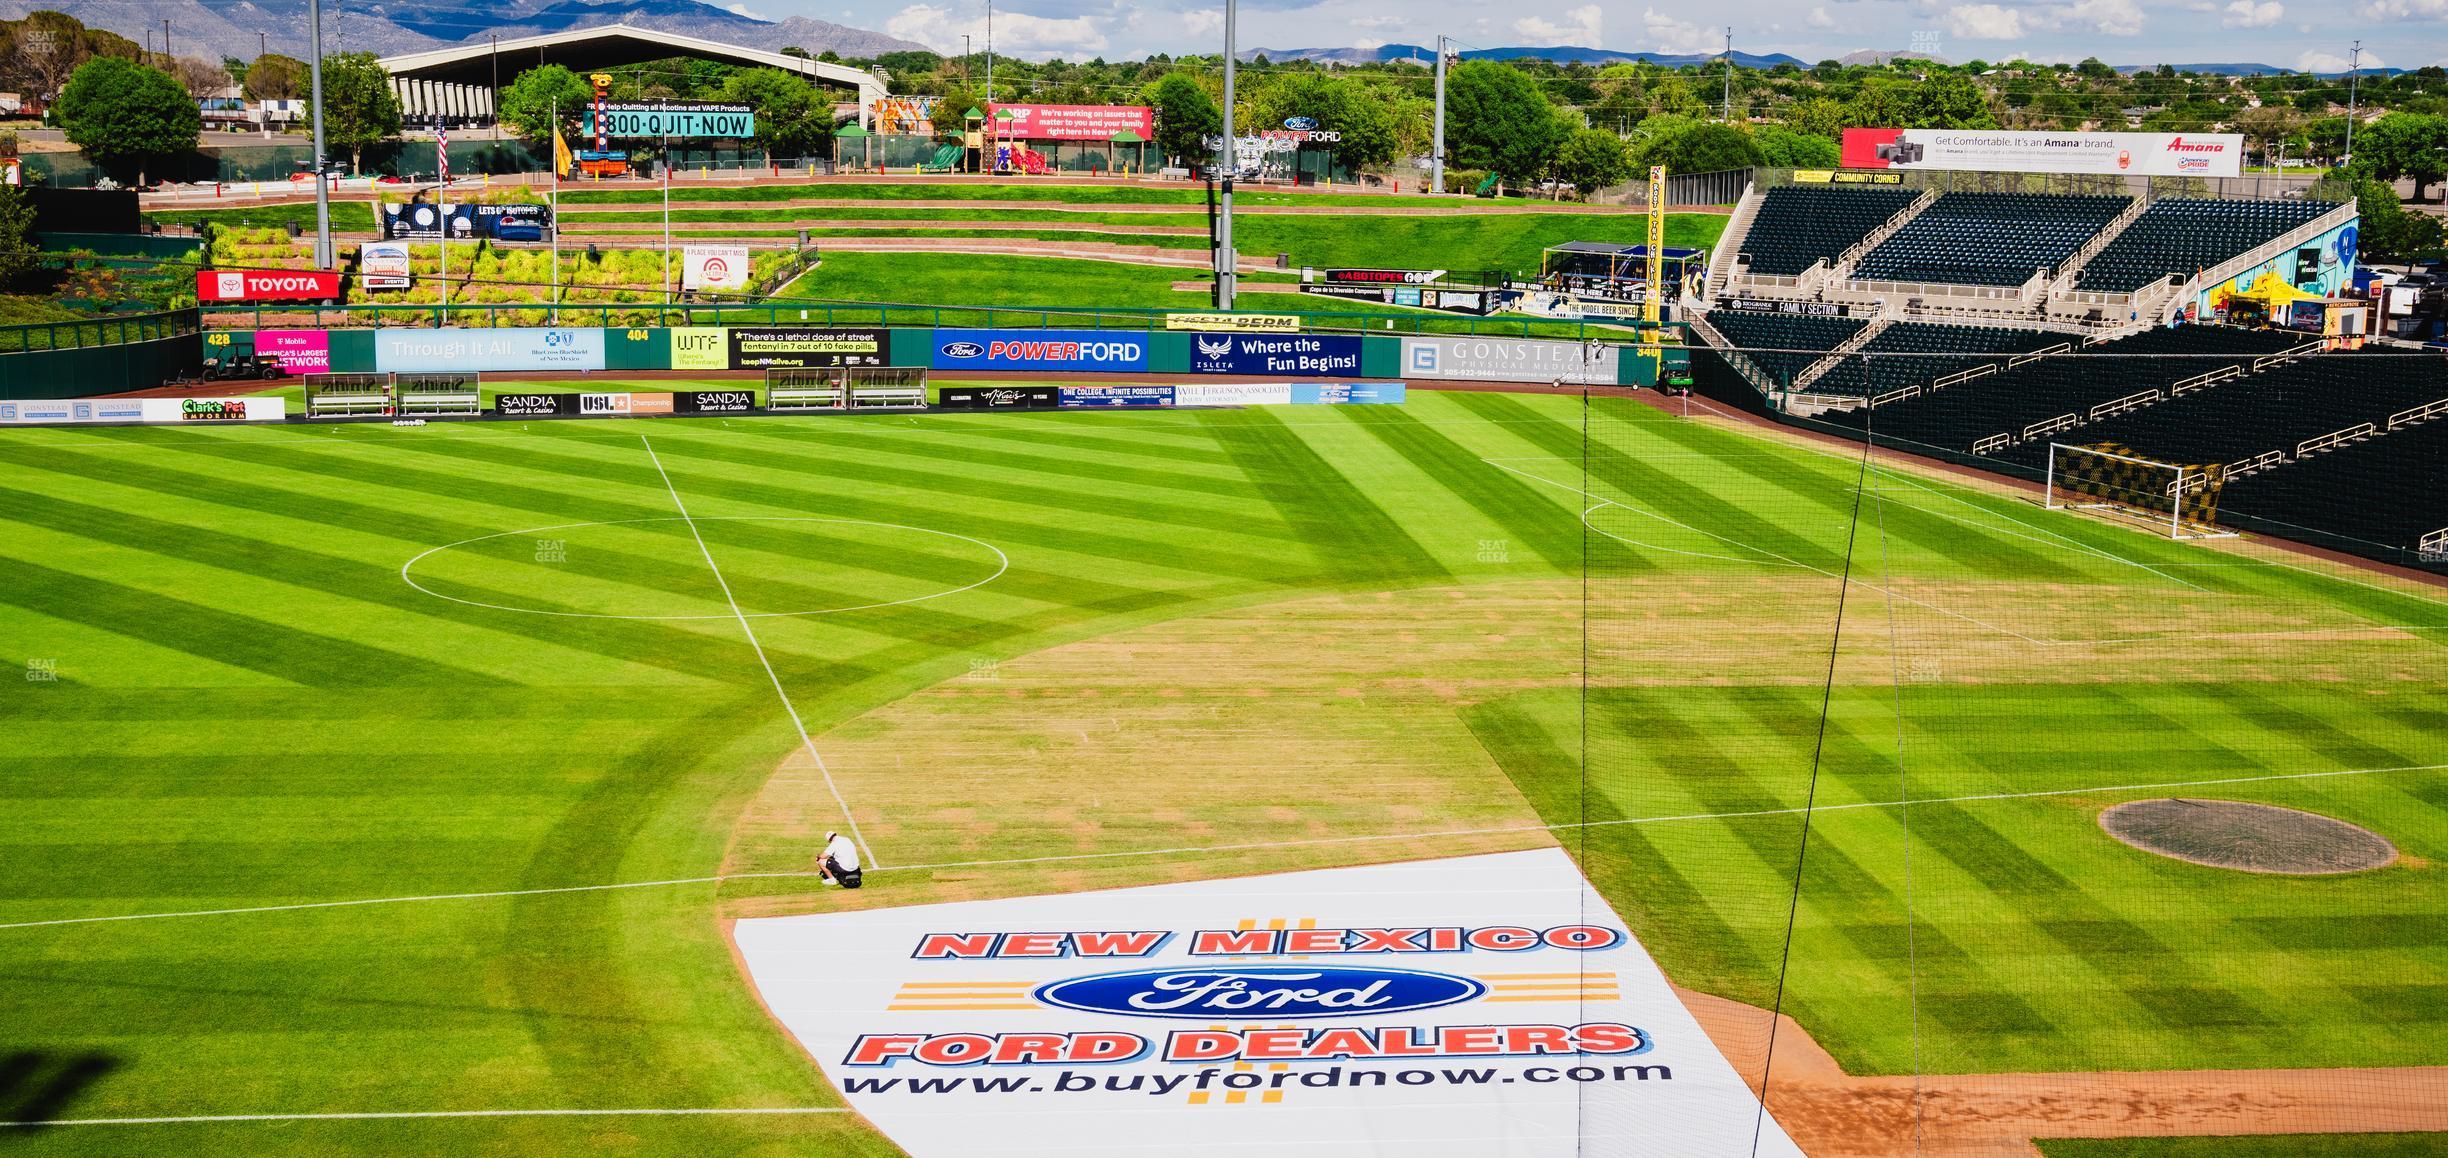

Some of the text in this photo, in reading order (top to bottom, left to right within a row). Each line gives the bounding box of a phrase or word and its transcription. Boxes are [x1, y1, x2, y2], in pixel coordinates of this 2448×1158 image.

[622, 103, 650, 112] Quitting
[1041, 109, 1060, 117] We're
[1061, 109, 1093, 119] working
[1104, 110, 1126, 118] issues
[1127, 110, 1142, 118] that
[1039, 118, 1063, 126] matter
[1074, 120, 1088, 128] you
[1089, 119, 1103, 127] and
[1121, 120, 1144, 128] family
[1047, 128, 1065, 136] right
[1066, 128, 1082, 136] here
[1935, 136, 1950, 146] Get
[1953, 136, 2012, 147] Comfortable.
[2014, 138, 2028, 147] It's
[2044, 138, 2080, 148] Amana
[2084, 139, 2115, 149] brand.
[2167, 136, 2224, 152] Amana
[1834, 172, 1872, 183] COMMUNITY
[1873, 173, 1900, 184] CORNER
[248, 277, 320, 292] TOYOTA
[1511, 282, 1544, 291] BEER HERE
[1570, 287, 1604, 297] BEER HERE
[1569, 303, 1579, 313] THE
[1581, 304, 1600, 314] MODEL
[1602, 305, 1616, 315] BEER
[1618, 306, 1636, 316] SINCE
[1779, 302, 1838, 316] FAMILY SECTION
[208, 333, 230, 345] 428
[627, 329, 649, 341] 404
[743, 332, 775, 341] There's
[785, 332, 810, 341] lethal
[812, 332, 832, 341] dose
[834, 333, 845, 341] of
[847, 333, 874, 342] street
[391, 341, 516, 358] Through It All.
[744, 342, 875, 351] fentanyl in 7 out of 10 fake pills.
[1242, 339, 1320, 355] Where the
[1453, 342, 1606, 363] GONSTEAD
[1637, 347, 1657, 357] 340
[297, 349, 328, 357] LARGEST
[741, 357, 803, 367] keepNMalive.org
[1267, 355, 1356, 372] Fun Begins!
[1461, 360, 1524, 370] PHYSICAL
[1063, 388, 1076, 396] ONE
[1077, 388, 1105, 397] COLLEGE,
[1105, 387, 1131, 396] INFINITE
[1132, 387, 1172, 396] POSSIBILITIES
[501, 395, 556, 408] SANDIA
[632, 400, 672, 408] Championship
[696, 392, 749, 405] SANDIA
[182, 399, 246, 413] Clark's Pet
[911, 925, 1625, 959] NEW MEXICO
[1129, 974, 1392, 1008] Ford
[842, 1022, 1652, 1068] FORD DEALERS
[843, 1065, 1673, 1095] www.buyfordnow.com
